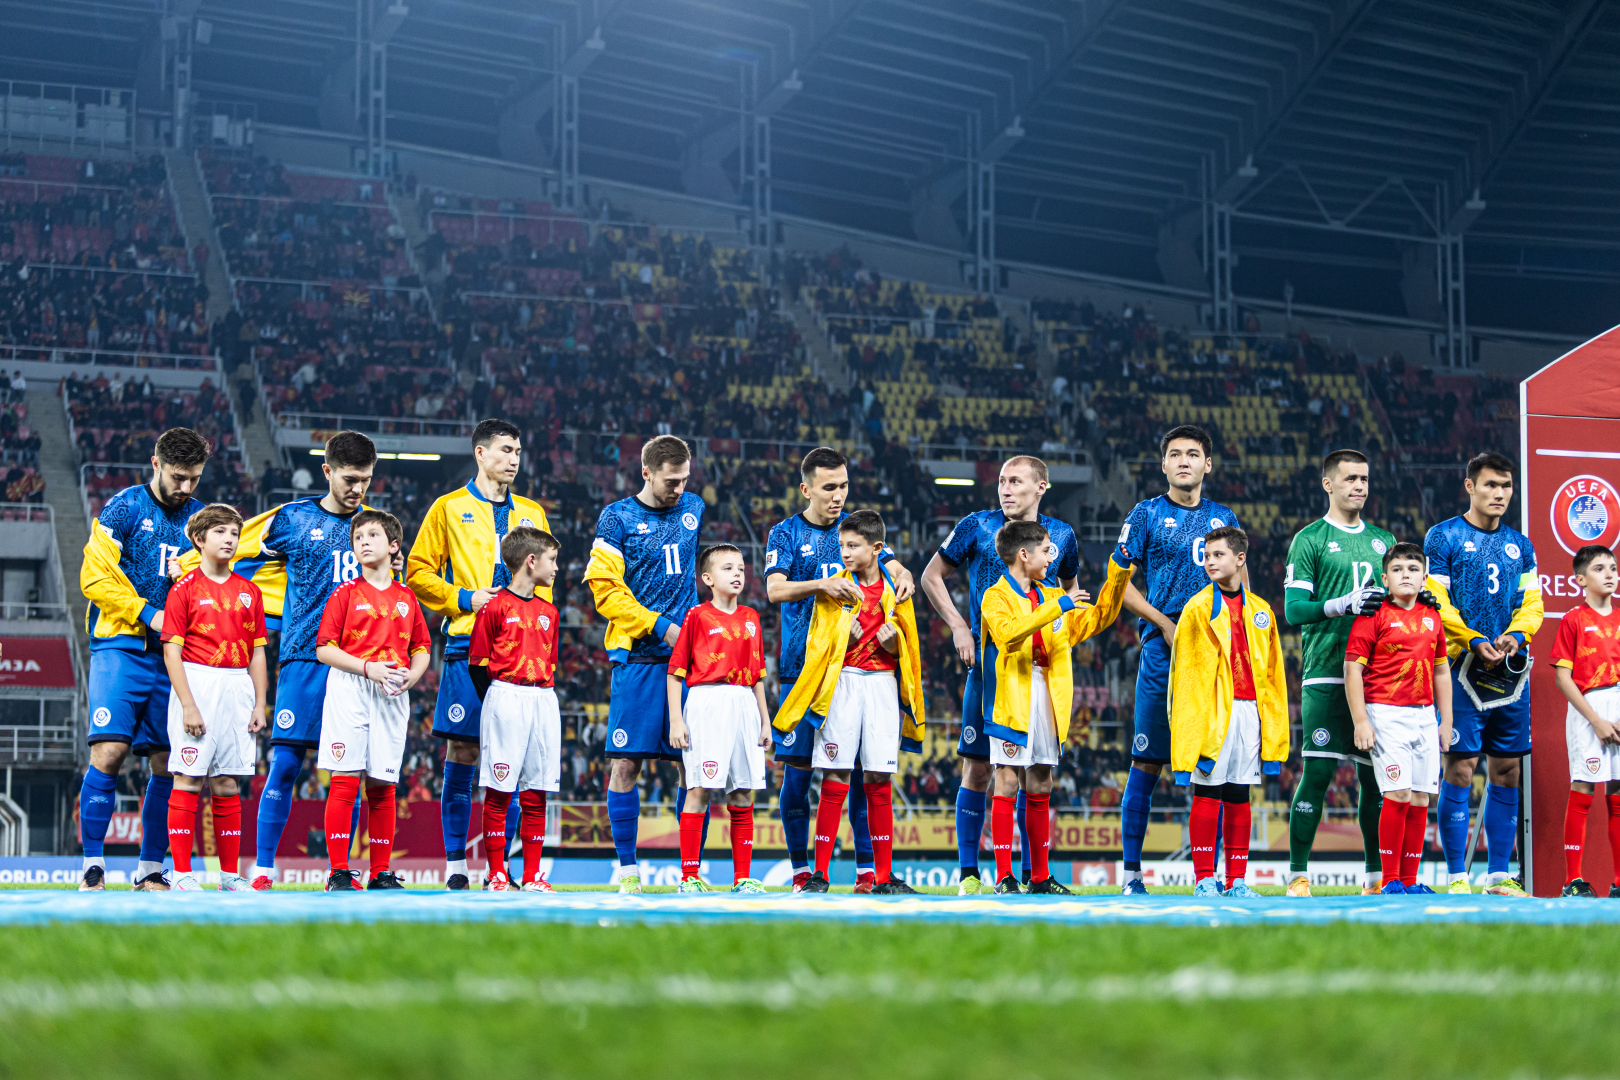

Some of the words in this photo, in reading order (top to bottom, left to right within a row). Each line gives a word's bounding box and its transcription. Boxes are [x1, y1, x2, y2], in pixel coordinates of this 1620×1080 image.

[1565, 481, 1608, 501] UEFA
[331, 550, 359, 583] 18
[662, 543, 682, 575] 11
[1351, 561, 1373, 591] 12
[1487, 563, 1500, 594] 3
[814, 834, 830, 842] AKO
